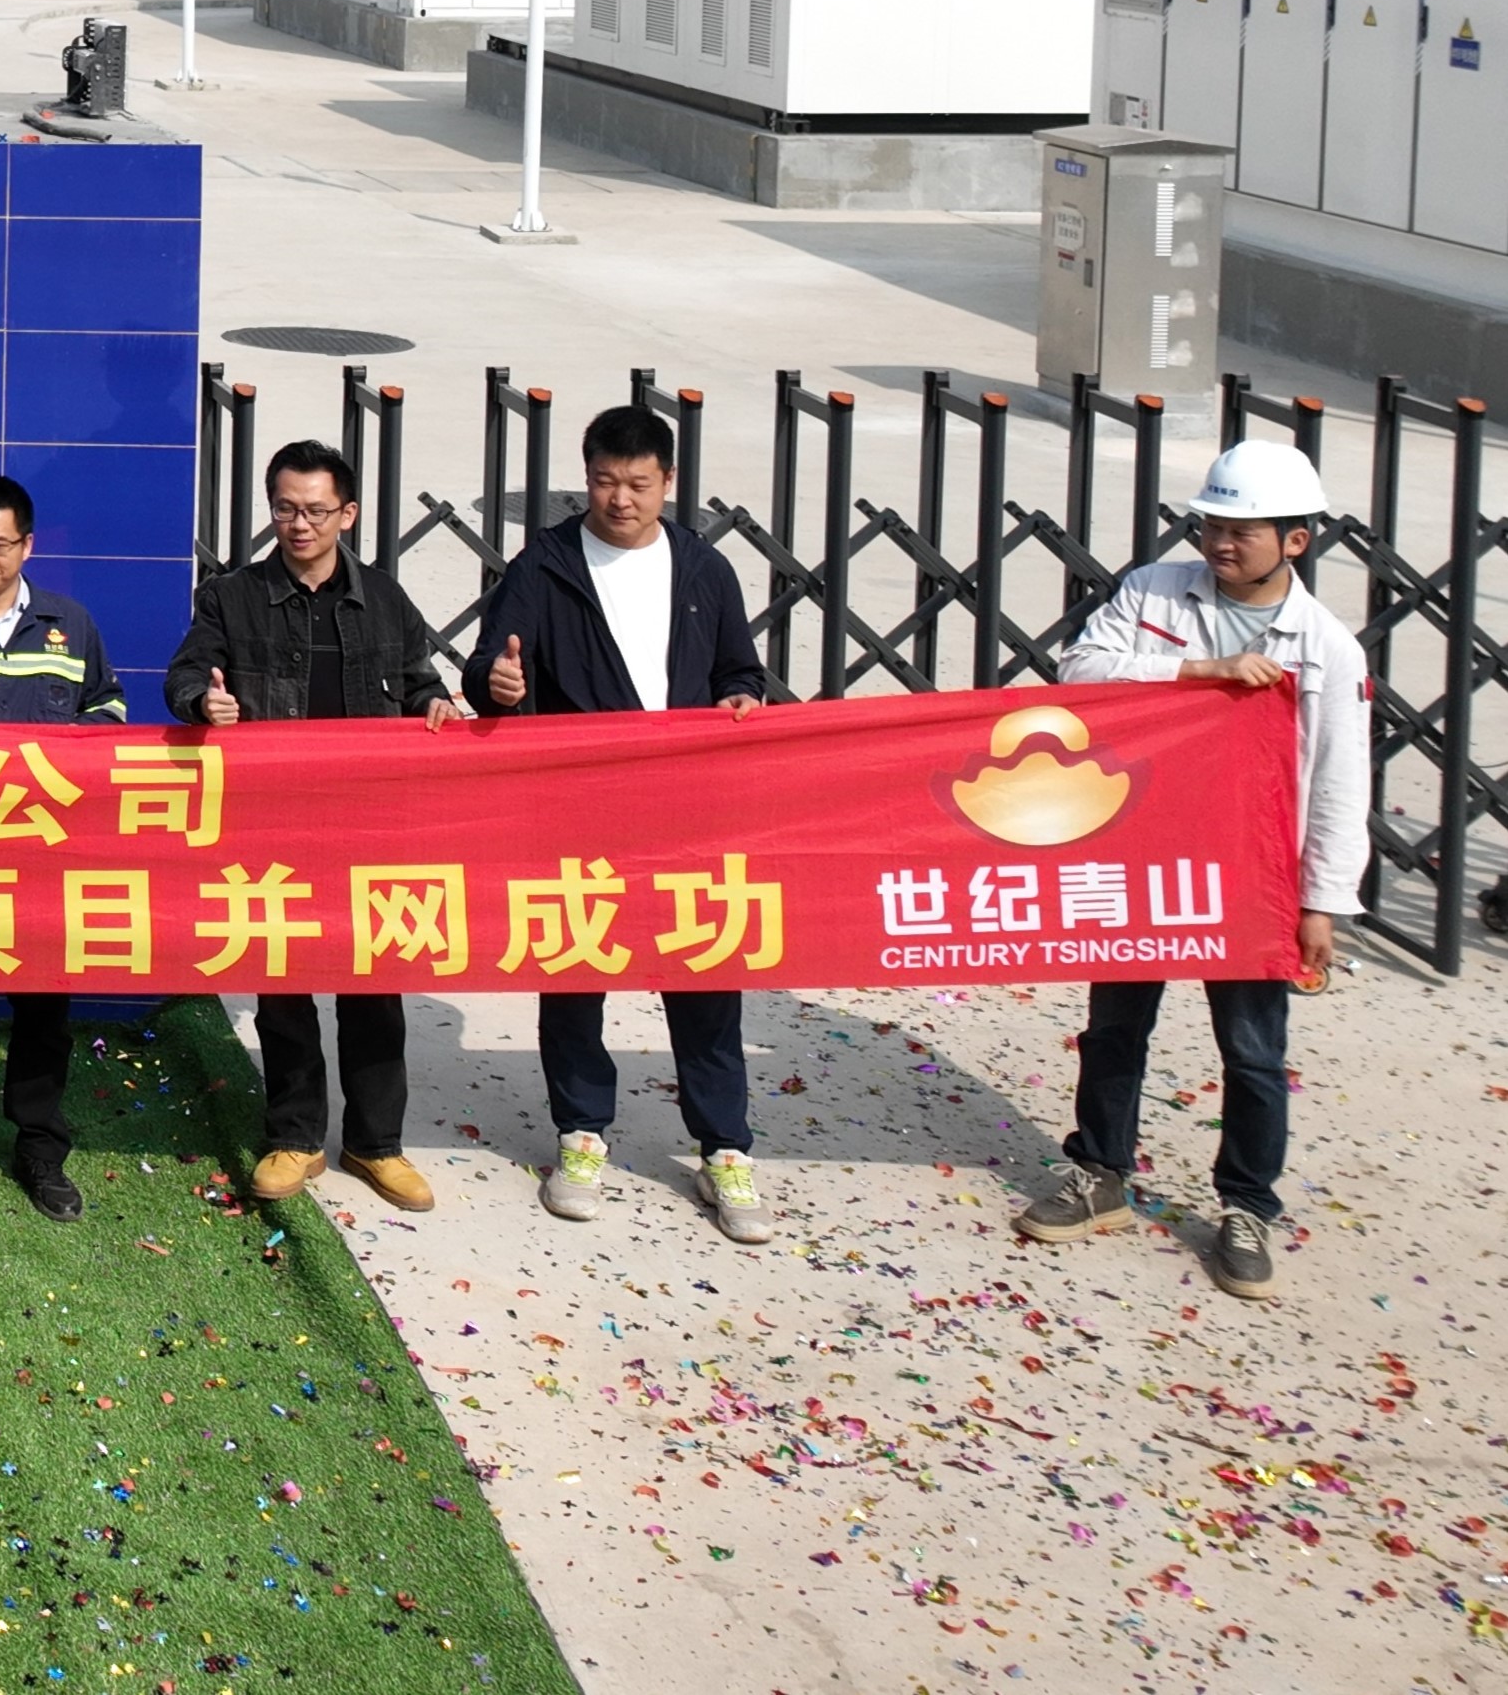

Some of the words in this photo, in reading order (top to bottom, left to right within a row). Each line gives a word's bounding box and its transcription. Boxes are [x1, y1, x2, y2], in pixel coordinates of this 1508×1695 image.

[876, 857, 1224, 937] 世纪青山
[879, 942, 1032, 970] CENTURY
[1038, 935, 1227, 965] TSINGSHAN
